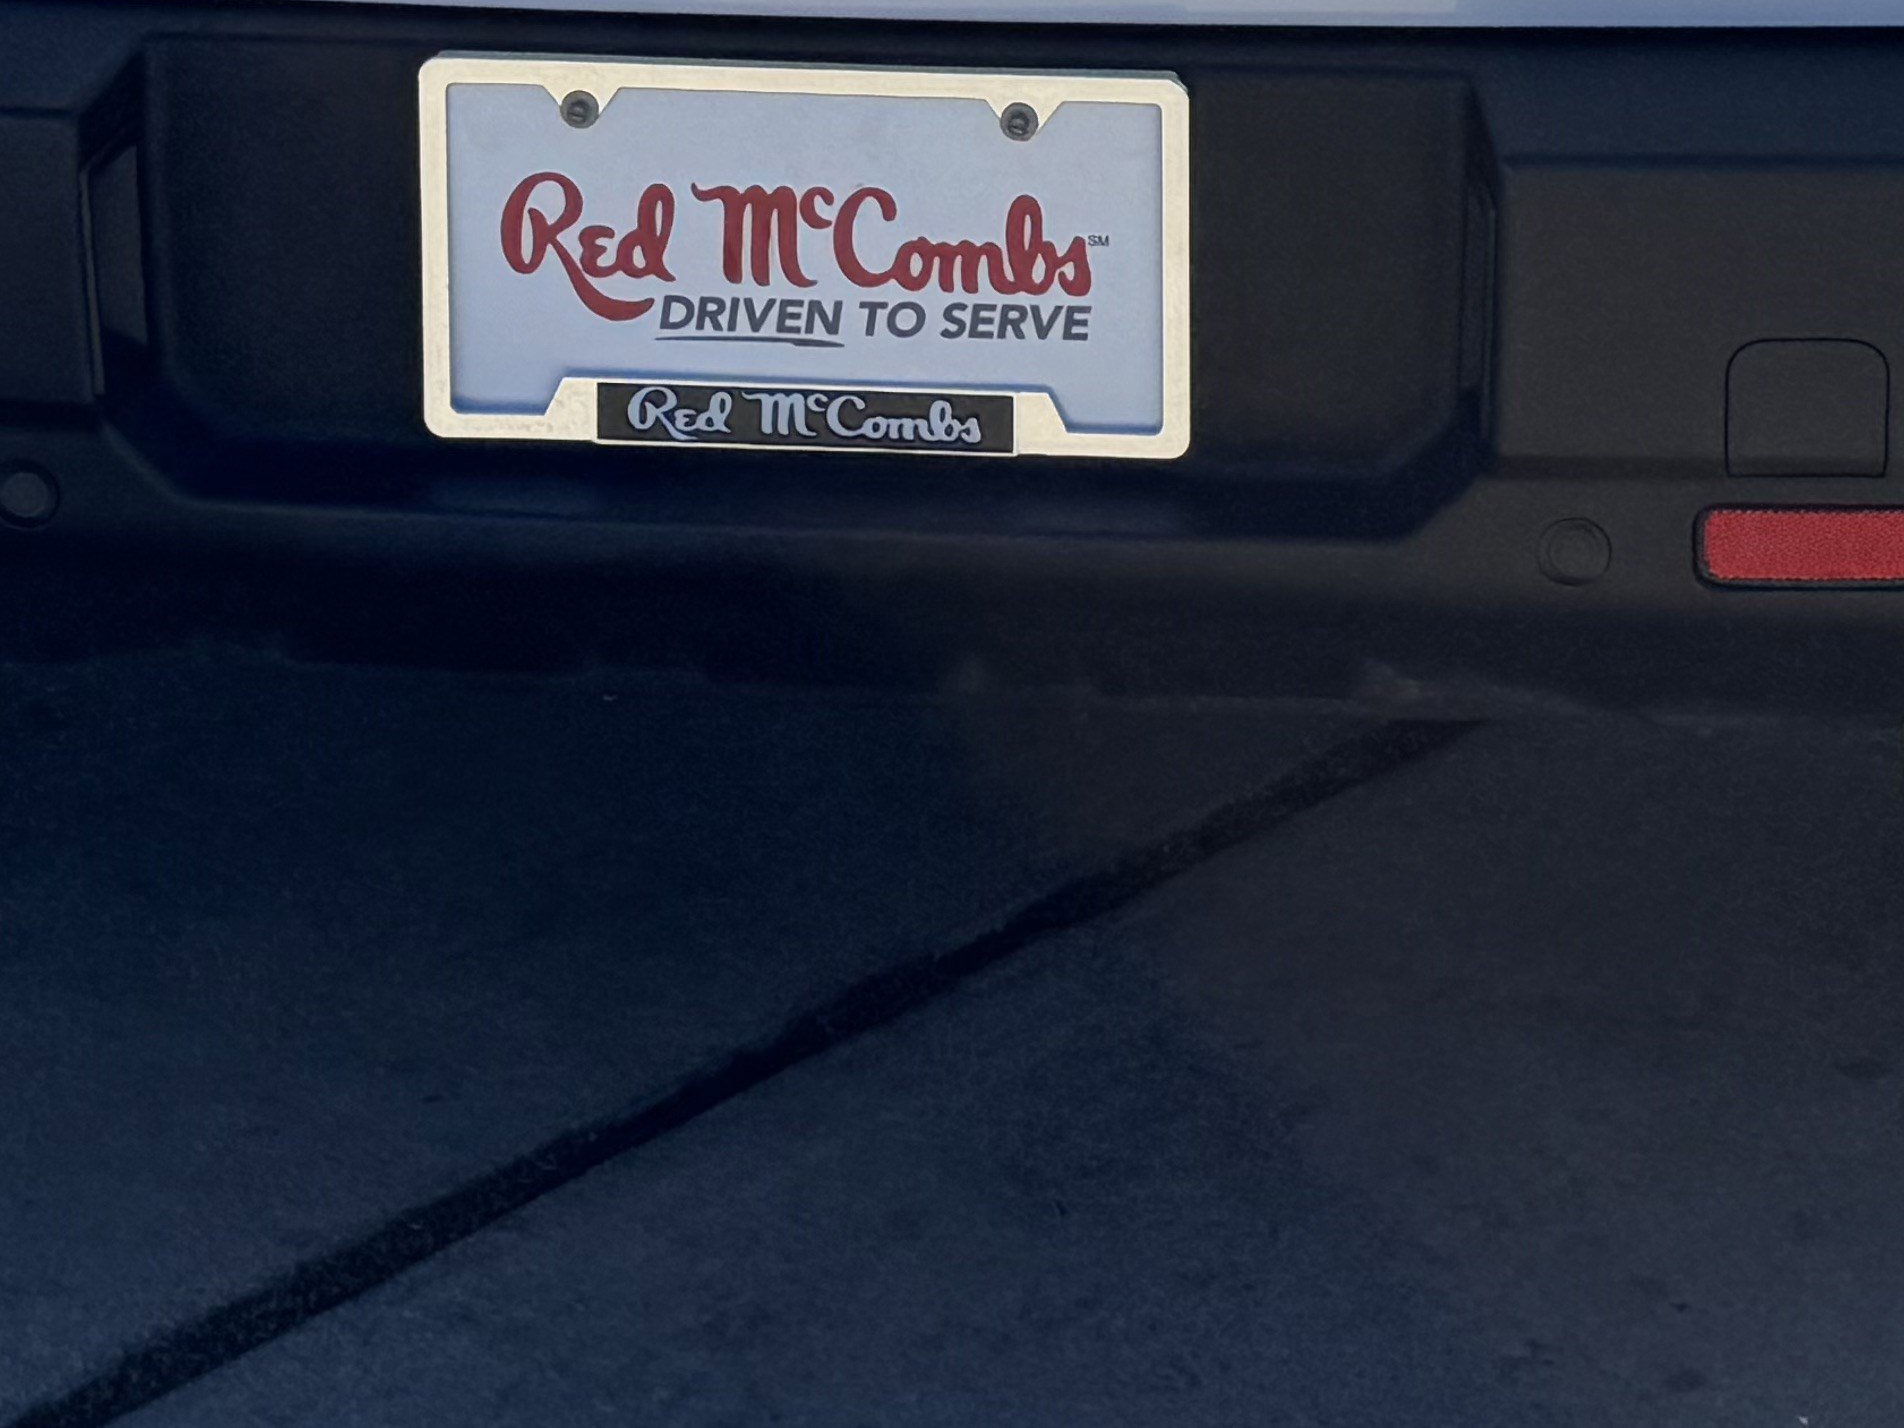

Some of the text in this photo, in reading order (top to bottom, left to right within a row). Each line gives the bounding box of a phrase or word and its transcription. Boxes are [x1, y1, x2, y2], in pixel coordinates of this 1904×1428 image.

[500, 171, 677, 322] Red
[690, 182, 1093, 297] McCombs
[659, 294, 1093, 342] DRIVEN TO SERVE
[627, 386, 982, 444] Red McCombs
